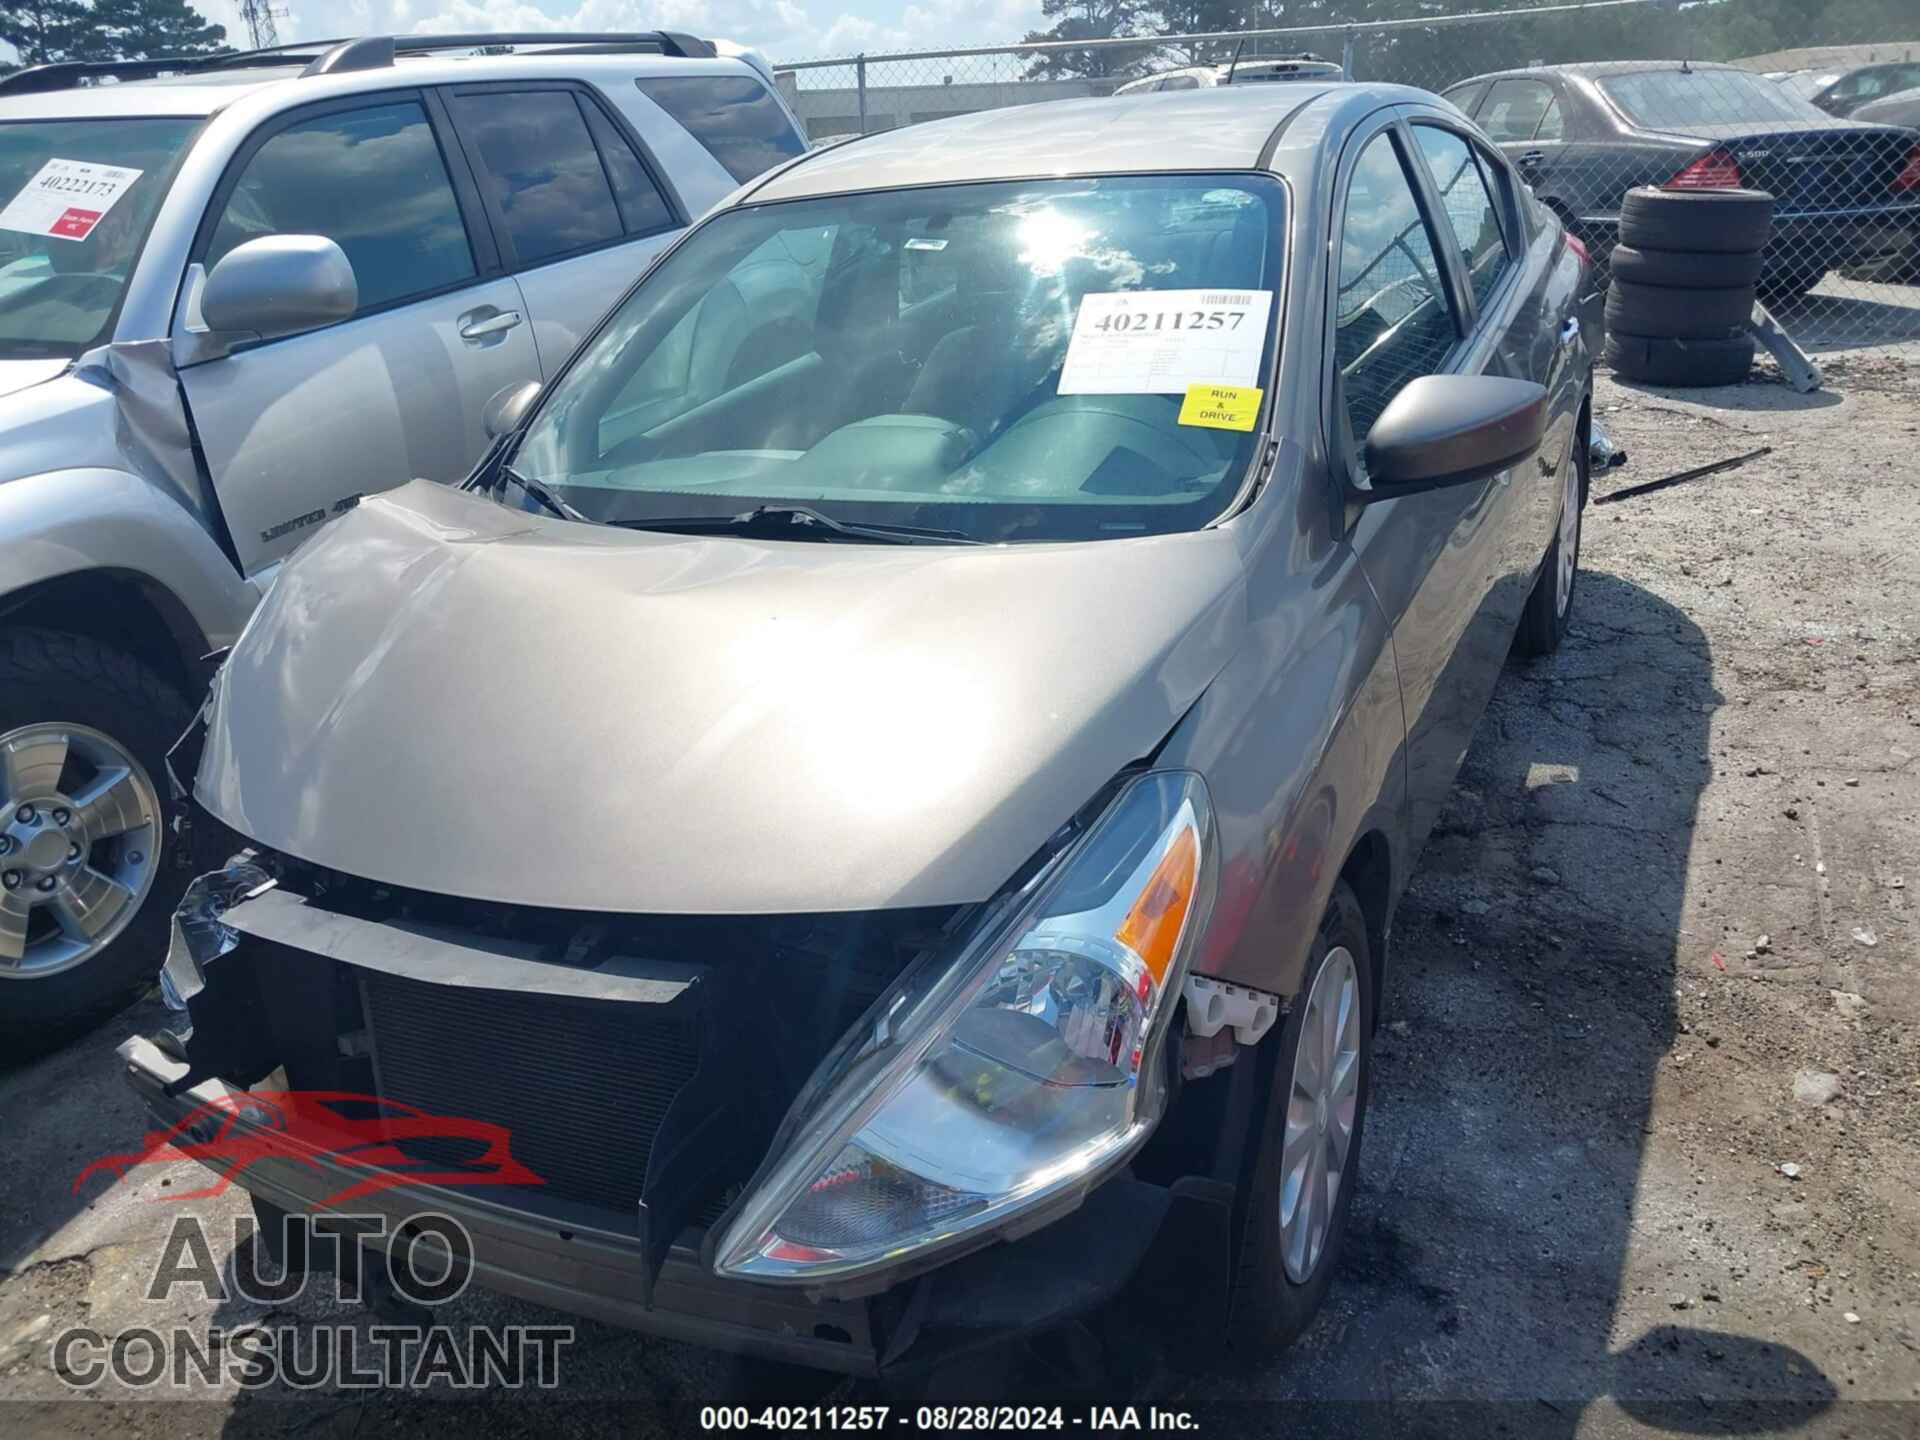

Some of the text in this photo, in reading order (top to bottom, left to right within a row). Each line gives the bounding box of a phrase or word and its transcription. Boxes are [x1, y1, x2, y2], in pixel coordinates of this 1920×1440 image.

[39, 175, 116, 197] 40222173
[1094, 310, 1246, 332] 40211257
[1210, 389, 1238, 400] RUN
[1199, 410, 1237, 422] DRIVE
